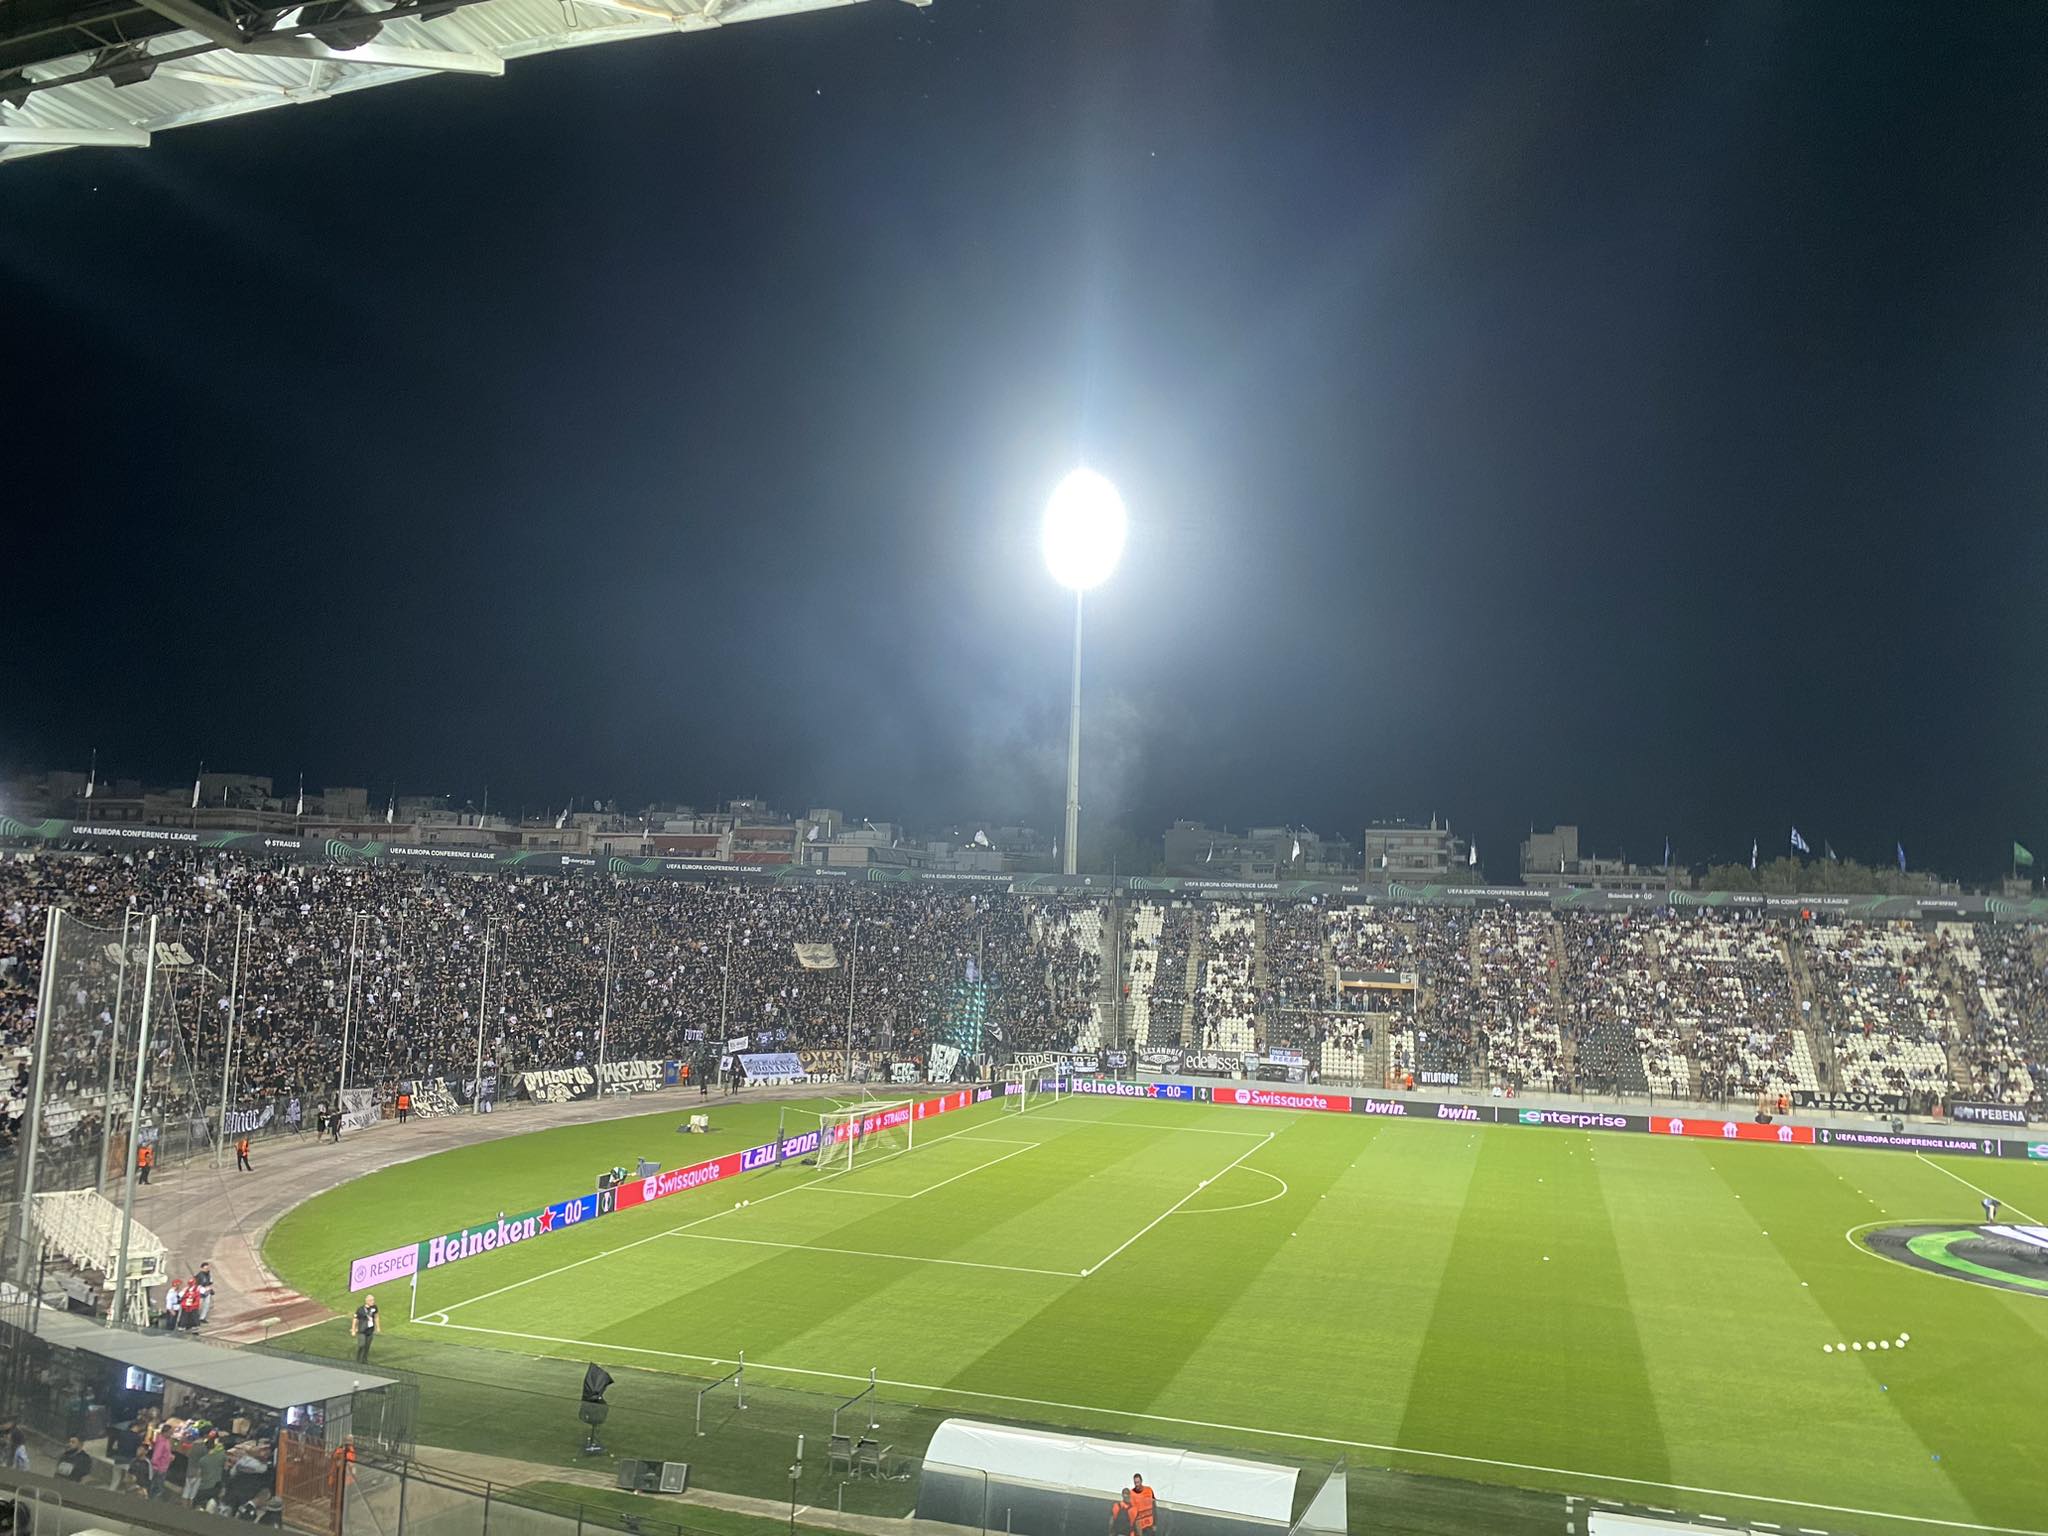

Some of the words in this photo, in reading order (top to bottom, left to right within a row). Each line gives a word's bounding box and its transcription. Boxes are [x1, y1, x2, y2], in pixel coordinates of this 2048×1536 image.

[73, 826, 92, 835] UEFA
[93, 828, 120, 837] EUROPA
[122, 829, 169, 839] CONFERENCE
[170, 832, 198, 841] LEAGUE
[272, 839, 300, 848] STRAUSS
[407, 848, 430, 856] EUROPA
[431, 850, 470, 858] CONFERENCE
[471, 851, 495, 859] LEAGUE
[1464, 888, 1485, 896] EUROPA
[1486, 889, 1525, 897] CONFERENCE
[1139, 1047, 1184, 1058] ALEXANDRIA
[1421, 1072, 1458, 1084] MYLOTOPOS
[1072, 1079, 1144, 1096] Heineken
[1252, 1091, 1328, 1109] Swissquote
[884, 1108, 909, 1126] STRAUSS
[1520, 1111, 1626, 1128] enterprise
[1836, 1134, 1856, 1142] UEFA
[1858, 1134, 1889, 1144] EUROPA
[1890, 1136, 1943, 1148] CONFERENCE
[1944, 1140, 1976, 1150] LEAGUE
[658, 1162, 720, 1195] Swissquote
[427, 1217, 536, 1269] Heineken
[370, 1252, 416, 1278] RESPECT
